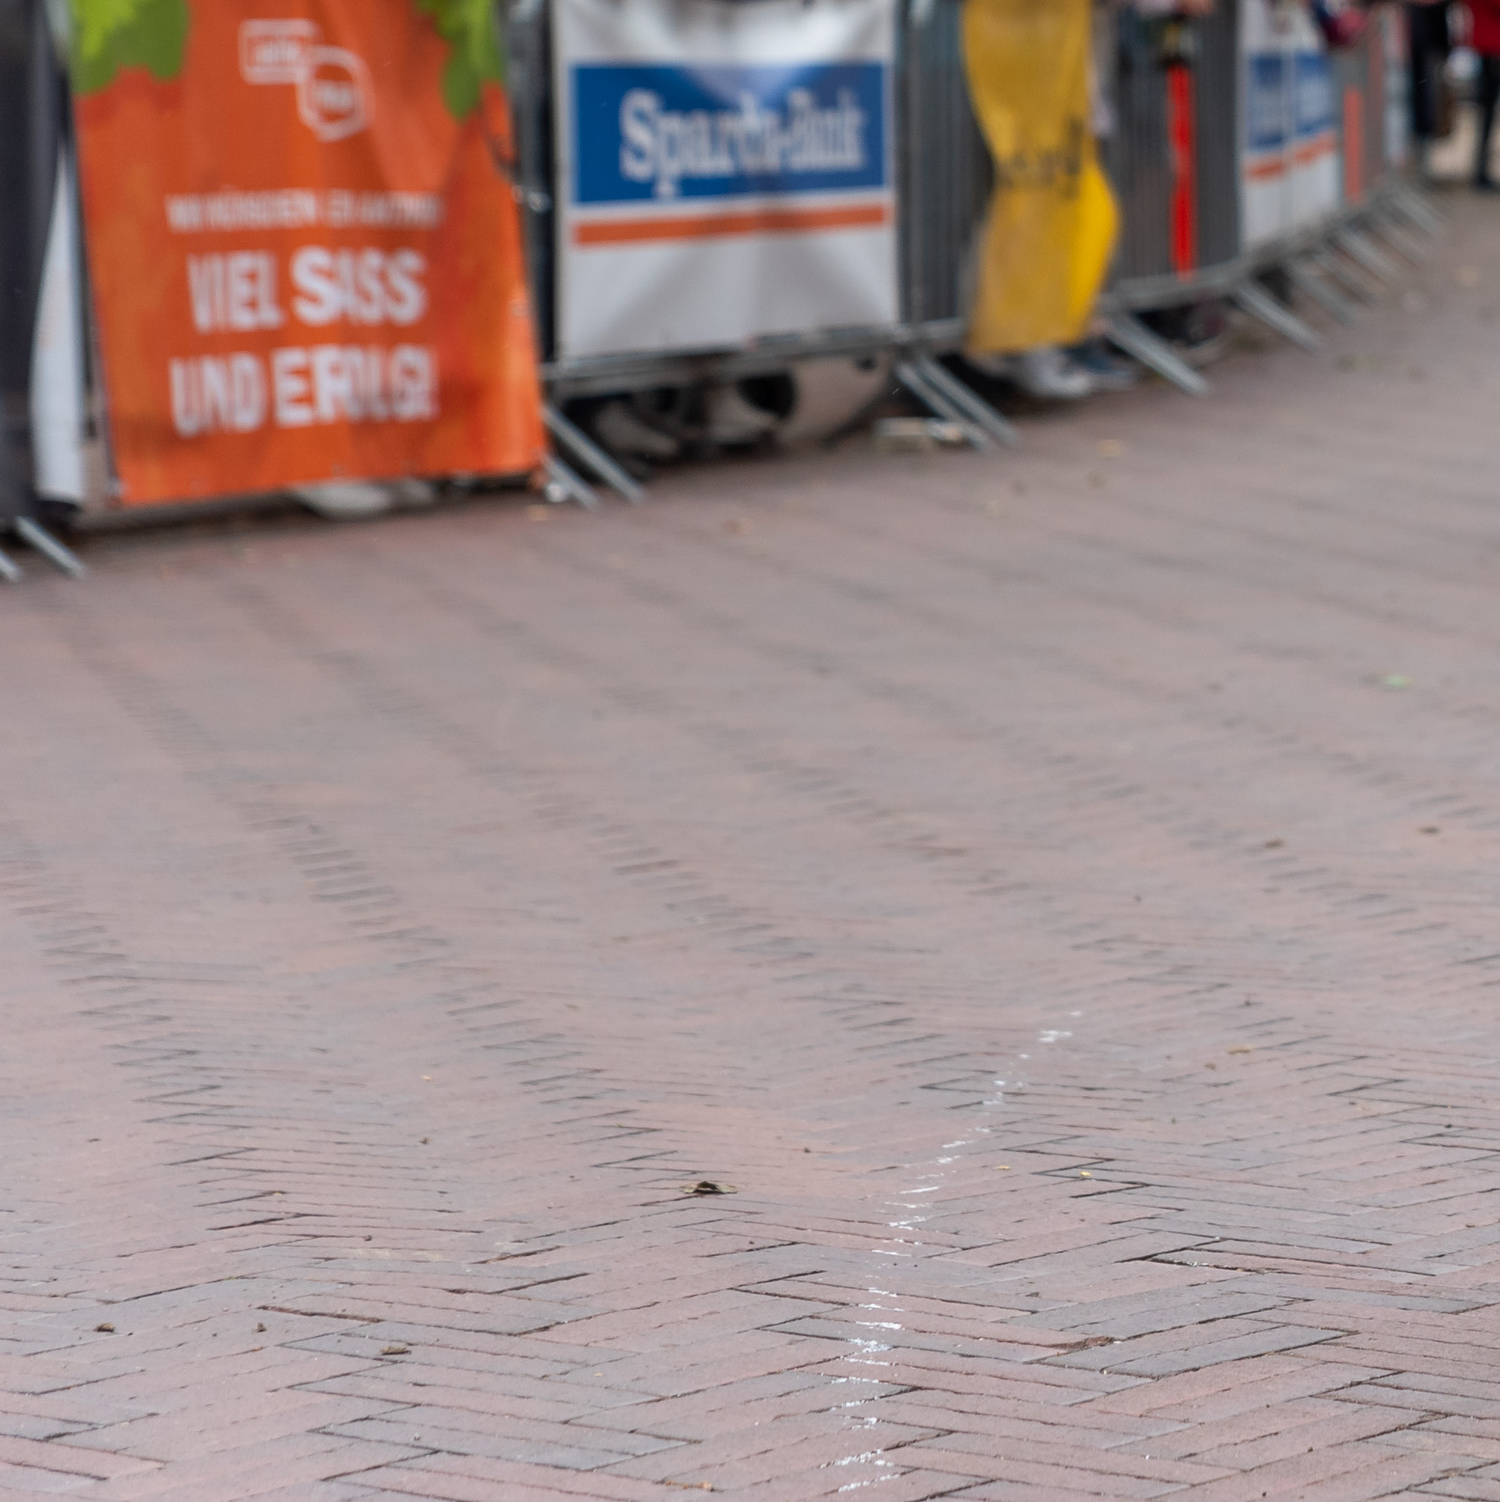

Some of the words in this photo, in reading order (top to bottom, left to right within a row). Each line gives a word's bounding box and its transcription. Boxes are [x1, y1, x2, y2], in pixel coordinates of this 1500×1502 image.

[187, 250, 285, 335] VIEL
[290, 244, 429, 327] SASS
[169, 352, 267, 437] UND
